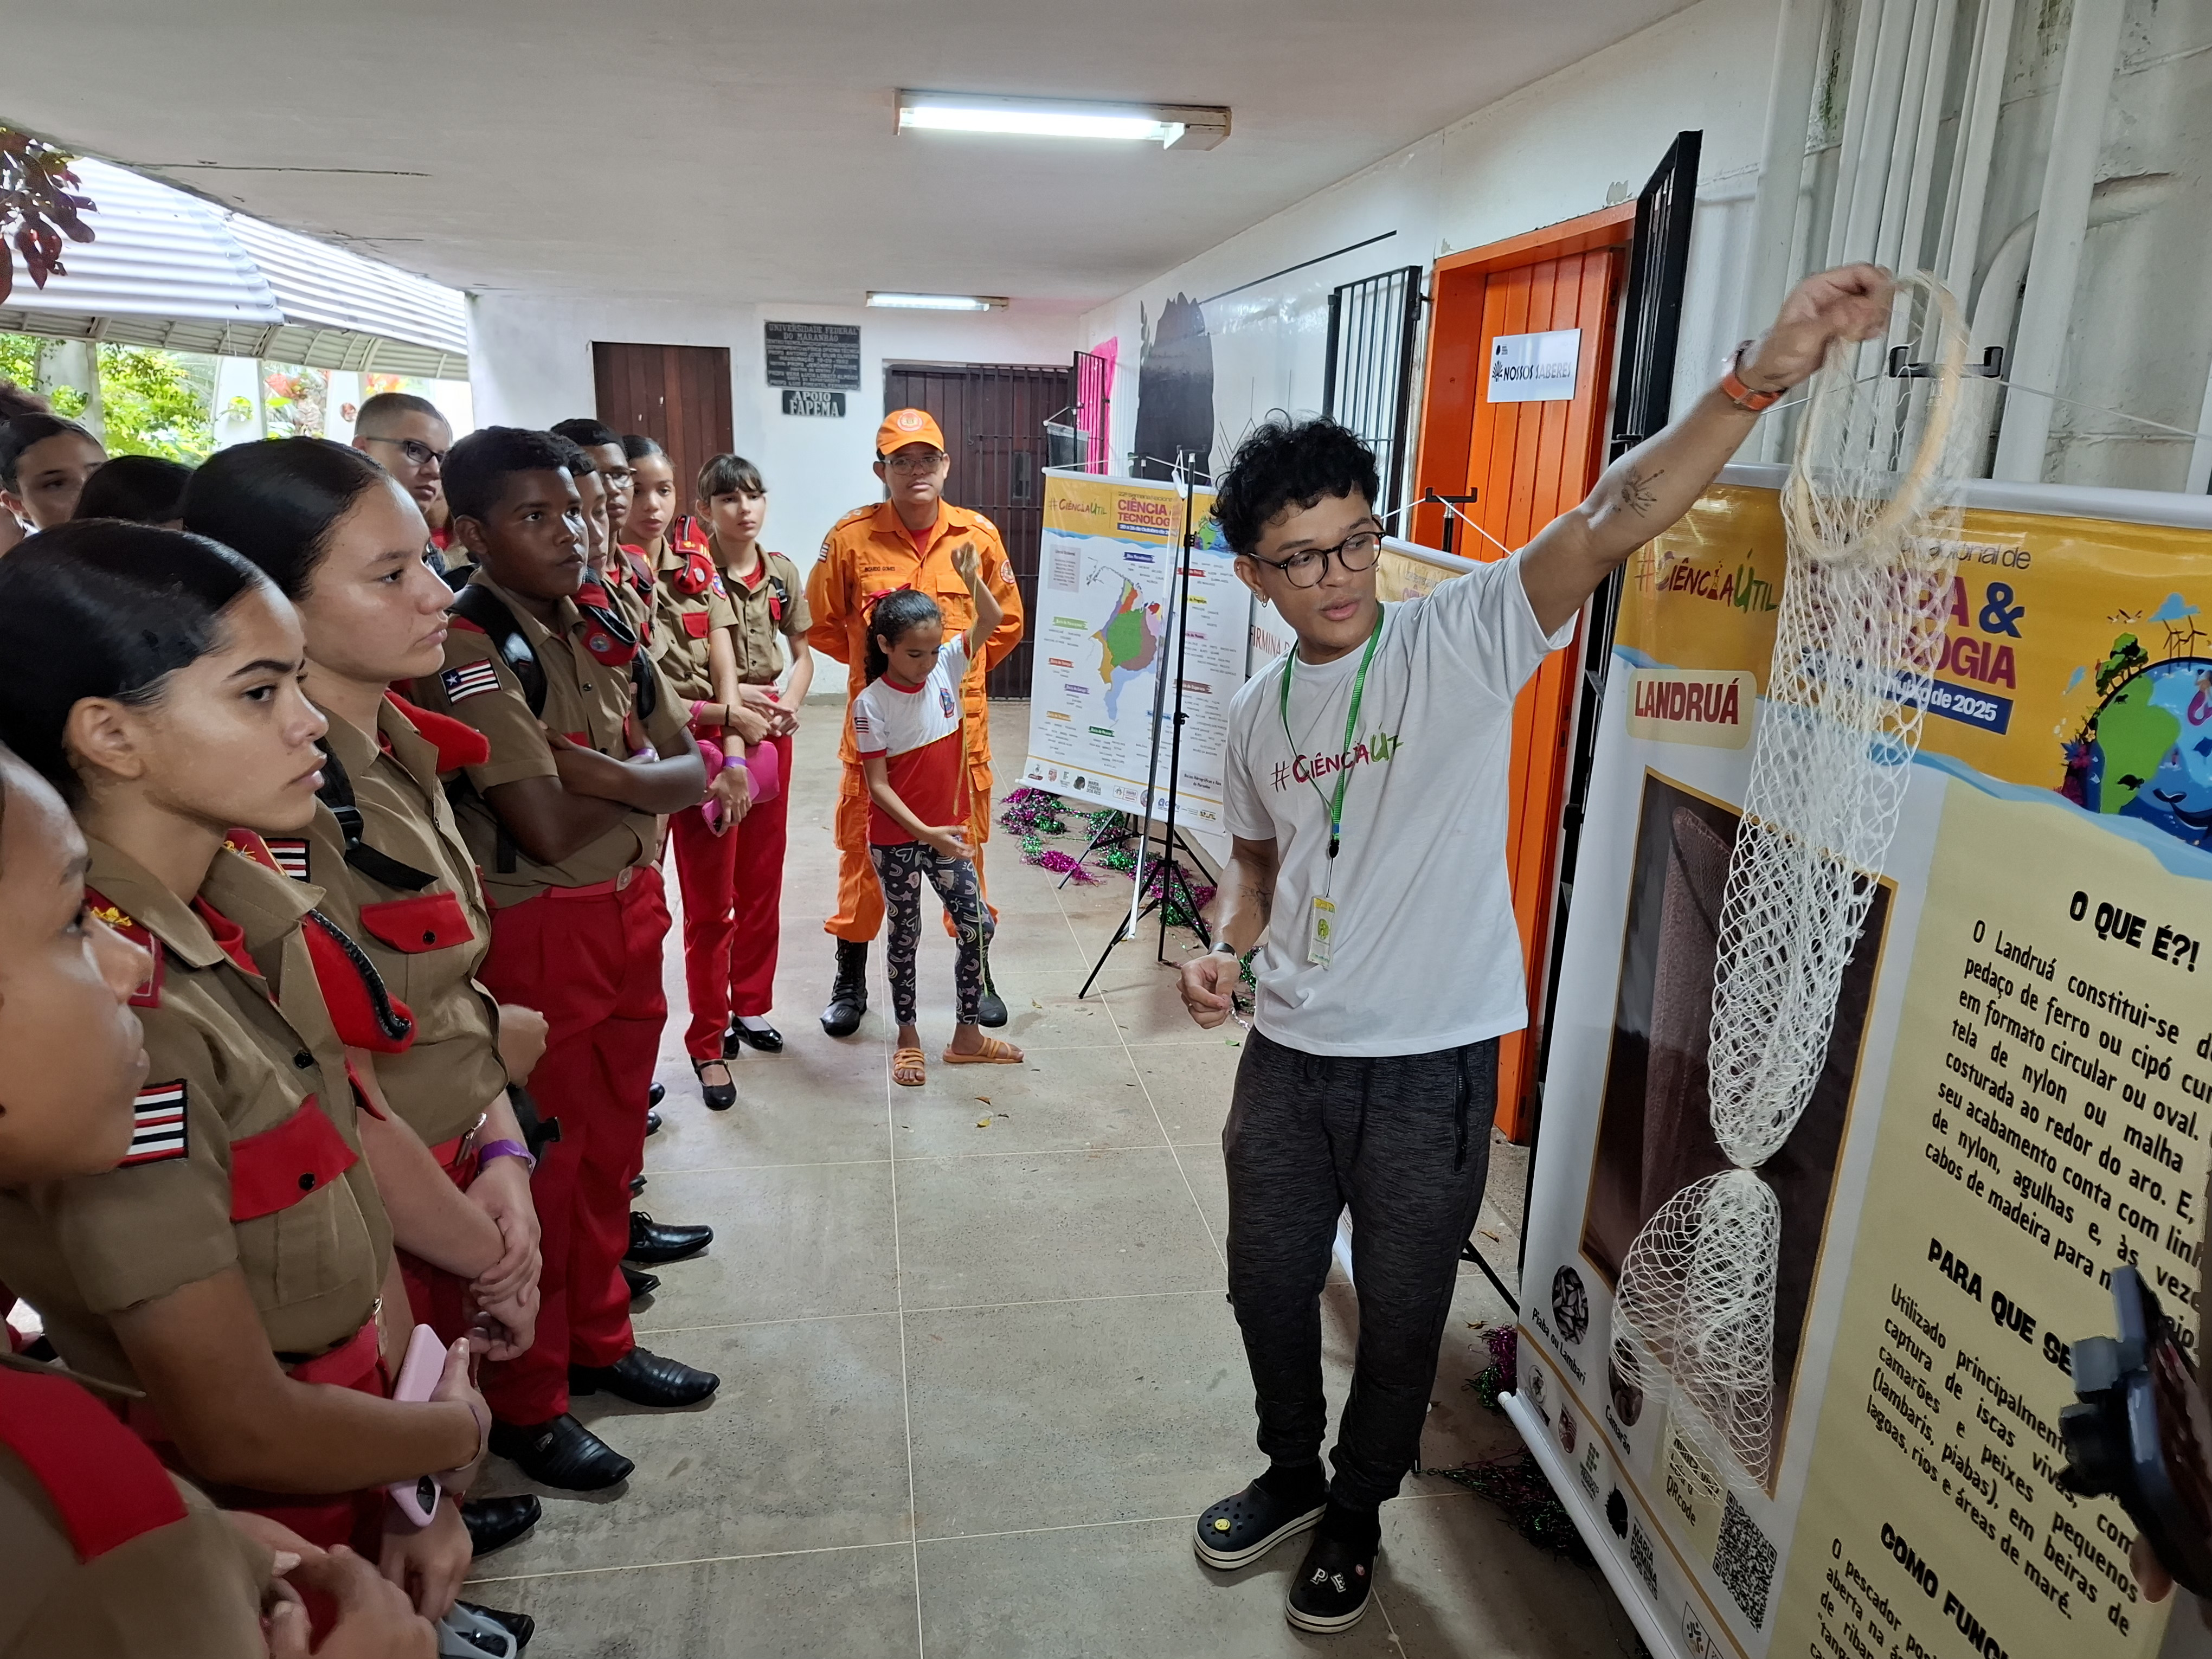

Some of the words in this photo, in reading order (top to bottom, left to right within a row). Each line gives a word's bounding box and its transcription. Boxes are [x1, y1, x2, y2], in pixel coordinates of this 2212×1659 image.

[769, 324, 822, 333] UNIVERSIDADE
[824, 326, 858, 335] FEDERAL
[790, 400, 839, 417] FAPEMA
[794, 391, 831, 401] APOIO
[1503, 364, 1534, 381] NOSSOS
[1535, 362, 1572, 380] SABERES
[1117, 498, 1168, 517] CIÊNCIA
[1117, 512, 1171, 527] TECNOLOG
[2002, 546, 2031, 570] de
[1249, 624, 1281, 658] FIRMINA
[1978, 581, 2025, 639] &
[1634, 677, 1740, 726] LANDRUÁ
[1931, 688, 1952, 708] de
[1952, 694, 1998, 722] 2025
[2069, 891, 2088, 921] O
[2094, 902, 2147, 949] QUE
[2151, 924, 2200, 973] É?!
[1964, 957, 2013, 999] pedaço
[2021, 983, 2038, 1011] de
[2044, 996, 2090, 1039] ferro
[2099, 1030, 2121, 1056] ou
[2131, 1045, 2172, 1082] cipó
[1973, 919, 1986, 943] O
[1995, 930, 2057, 982] Landruá
[2068, 974, 2179, 1045] constitui-se
[2196, 1033, 2212, 1063] d
[1952, 1018, 1978, 1049] tela
[1990, 1040, 2008, 1068] de
[2022, 1063, 2067, 1104] nylon
[2084, 1100, 2106, 1127] ou
[2124, 1123, 2183, 1173] malha
[1959, 989, 1980, 1014] em
[1984, 1000, 2046, 1052] formato
[2051, 1040, 2117, 1092] circular
[2123, 1084, 2146, 1110] ou
[2153, 1100, 2199, 1141] oval.
[1938, 1082, 1962, 1110] seu
[1965, 1099, 2057, 1173] acabamento
[2062, 1165, 2112, 1211] conta
[2118, 1203, 2159, 1243] com
[2166, 1225, 2196, 1268] lin
[1946, 1051, 2014, 1108] costurada
[2021, 1101, 2039, 1124] ao
[2045, 1114, 2093, 1156] redor
[2098, 1145, 2121, 1176] do
[2129, 1168, 2166, 1206] aro.
[2176, 1188, 2195, 1225] E,
[1925, 1142, 1963, 1181] cabos
[1967, 1170, 1984, 1198] de
[1988, 1188, 2051, 1247] madeira
[2054, 1238, 2094, 1278] para
[1932, 1108, 1949, 1136] de
[1957, 1129, 2001, 1175] nylon,
[2012, 1169, 2075, 1224] agulhas
[2088, 1222, 2101, 1246] e,
[2117, 1234, 2139, 1266] às
[1927, 1237, 1983, 1302] PARA
[1991, 1290, 2036, 1345] QUE
[1532, 1306, 1549, 1339] Piaba
[1551, 1334, 1560, 1353] ou
[1560, 1341, 1586, 1386] Lambari
[1891, 1282, 1947, 1350] Utilizado
[1955, 1349, 2066, 1456] principalment
[1605, 1405, 1630, 1456] Camarão
[1884, 1317, 1933, 1372] captura
[1945, 1374, 1963, 1401] de
[1976, 1397, 2016, 1449] iscas
[2097, 1513, 2134, 1550] com
[1667, 1475, 1696, 1527] QRcode
[1866, 1394, 1910, 1455] lagoas,
[1912, 1446, 1938, 1483] rios
[1941, 1478, 1953, 1496] e
[1956, 1487, 1996, 1542] áreas
[2000, 1533, 2021, 1565] de
[2025, 1558, 2074, 1622] maré.
[1872, 1367, 1935, 1446] (lambaris,
[1941, 1443, 2000, 1511] piabas),
[2008, 1509, 2035, 1544] em
[2044, 1534, 2098, 1604] beiras
[2107, 1602, 2130, 1638] de
[1878, 1346, 1941, 1414] camarões
[1956, 1422, 1966, 1438] e
[1980, 1444, 2035, 1503] peixes
[2052, 1510, 2138, 1604] pequenos
[1310, 1567, 1328, 1585] P
[1330, 1572, 1346, 1593] E
[1630, 1547, 1642, 1576] DOS
[1643, 1571, 1657, 1600] REIS
[1631, 1535, 1657, 1588] FIRMINA
[1633, 1523, 1653, 1565] MARIA
[1821, 1591, 1834, 1618] de
[1826, 1567, 1863, 1622] aberta
[1868, 1620, 1884, 1648] na
[1832, 1538, 1842, 1559] O
[1844, 1559, 1902, 1631] pescador
[1881, 1522, 1938, 1599] COMO
[1943, 1589, 2009, 1659] FUNC
